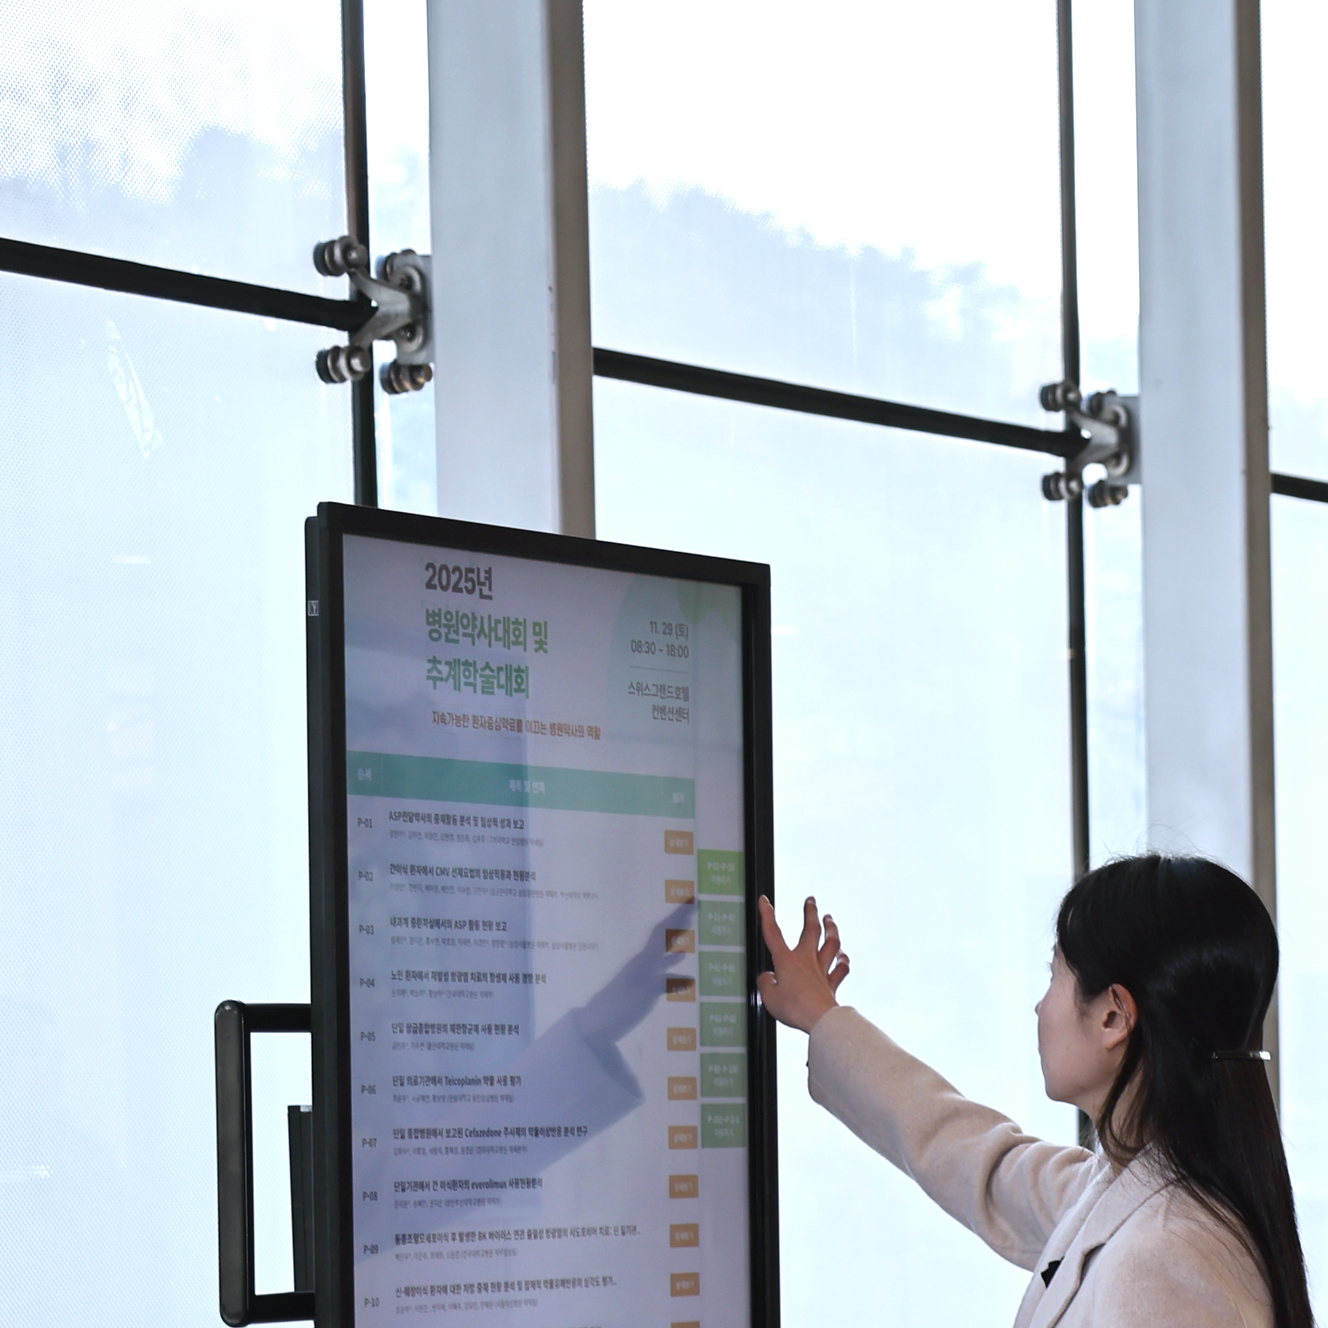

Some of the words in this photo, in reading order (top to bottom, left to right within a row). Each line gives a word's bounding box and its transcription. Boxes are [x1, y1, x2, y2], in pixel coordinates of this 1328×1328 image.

[425, 562, 493, 600] 2025년
[425, 607, 528, 652] 병원약사대회
[533, 620, 548, 654] 및
[649, 620, 660, 635] 11.
[661, 621, 673, 636] 29
[674, 622, 689, 640] (토)
[631, 641, 656, 655] 08:30
[665, 644, 689, 659] 18:00
[425, 655, 530, 700] 추계학술대회
[628, 682, 690, 703] 스위스그랜드호텔
[651, 704, 690, 723] 컨벤션센터
[432, 710, 470, 728] 지속가능한
[472, 714, 523, 733] 환자중심약료를
[526, 719, 547, 735] 이끄는
[549, 721, 585, 738] 병원약사의
[587, 725, 601, 740] 역할
[358, 817, 372, 828] P-01
[358, 870, 373, 882] P-02
[359, 925, 374, 935] P-03
[453, 919, 466, 931] ASP
[360, 978, 375, 988] P-04
[361, 1032, 375, 1041] P-05
[361, 1085, 376, 1094] P-06
[362, 1138, 377, 1147] P-07
[363, 1191, 378, 1201] P-08
[470, 1179, 506, 1190] everolimus
[364, 1244, 378, 1254] P-09
[364, 1298, 379, 1307] P-10
